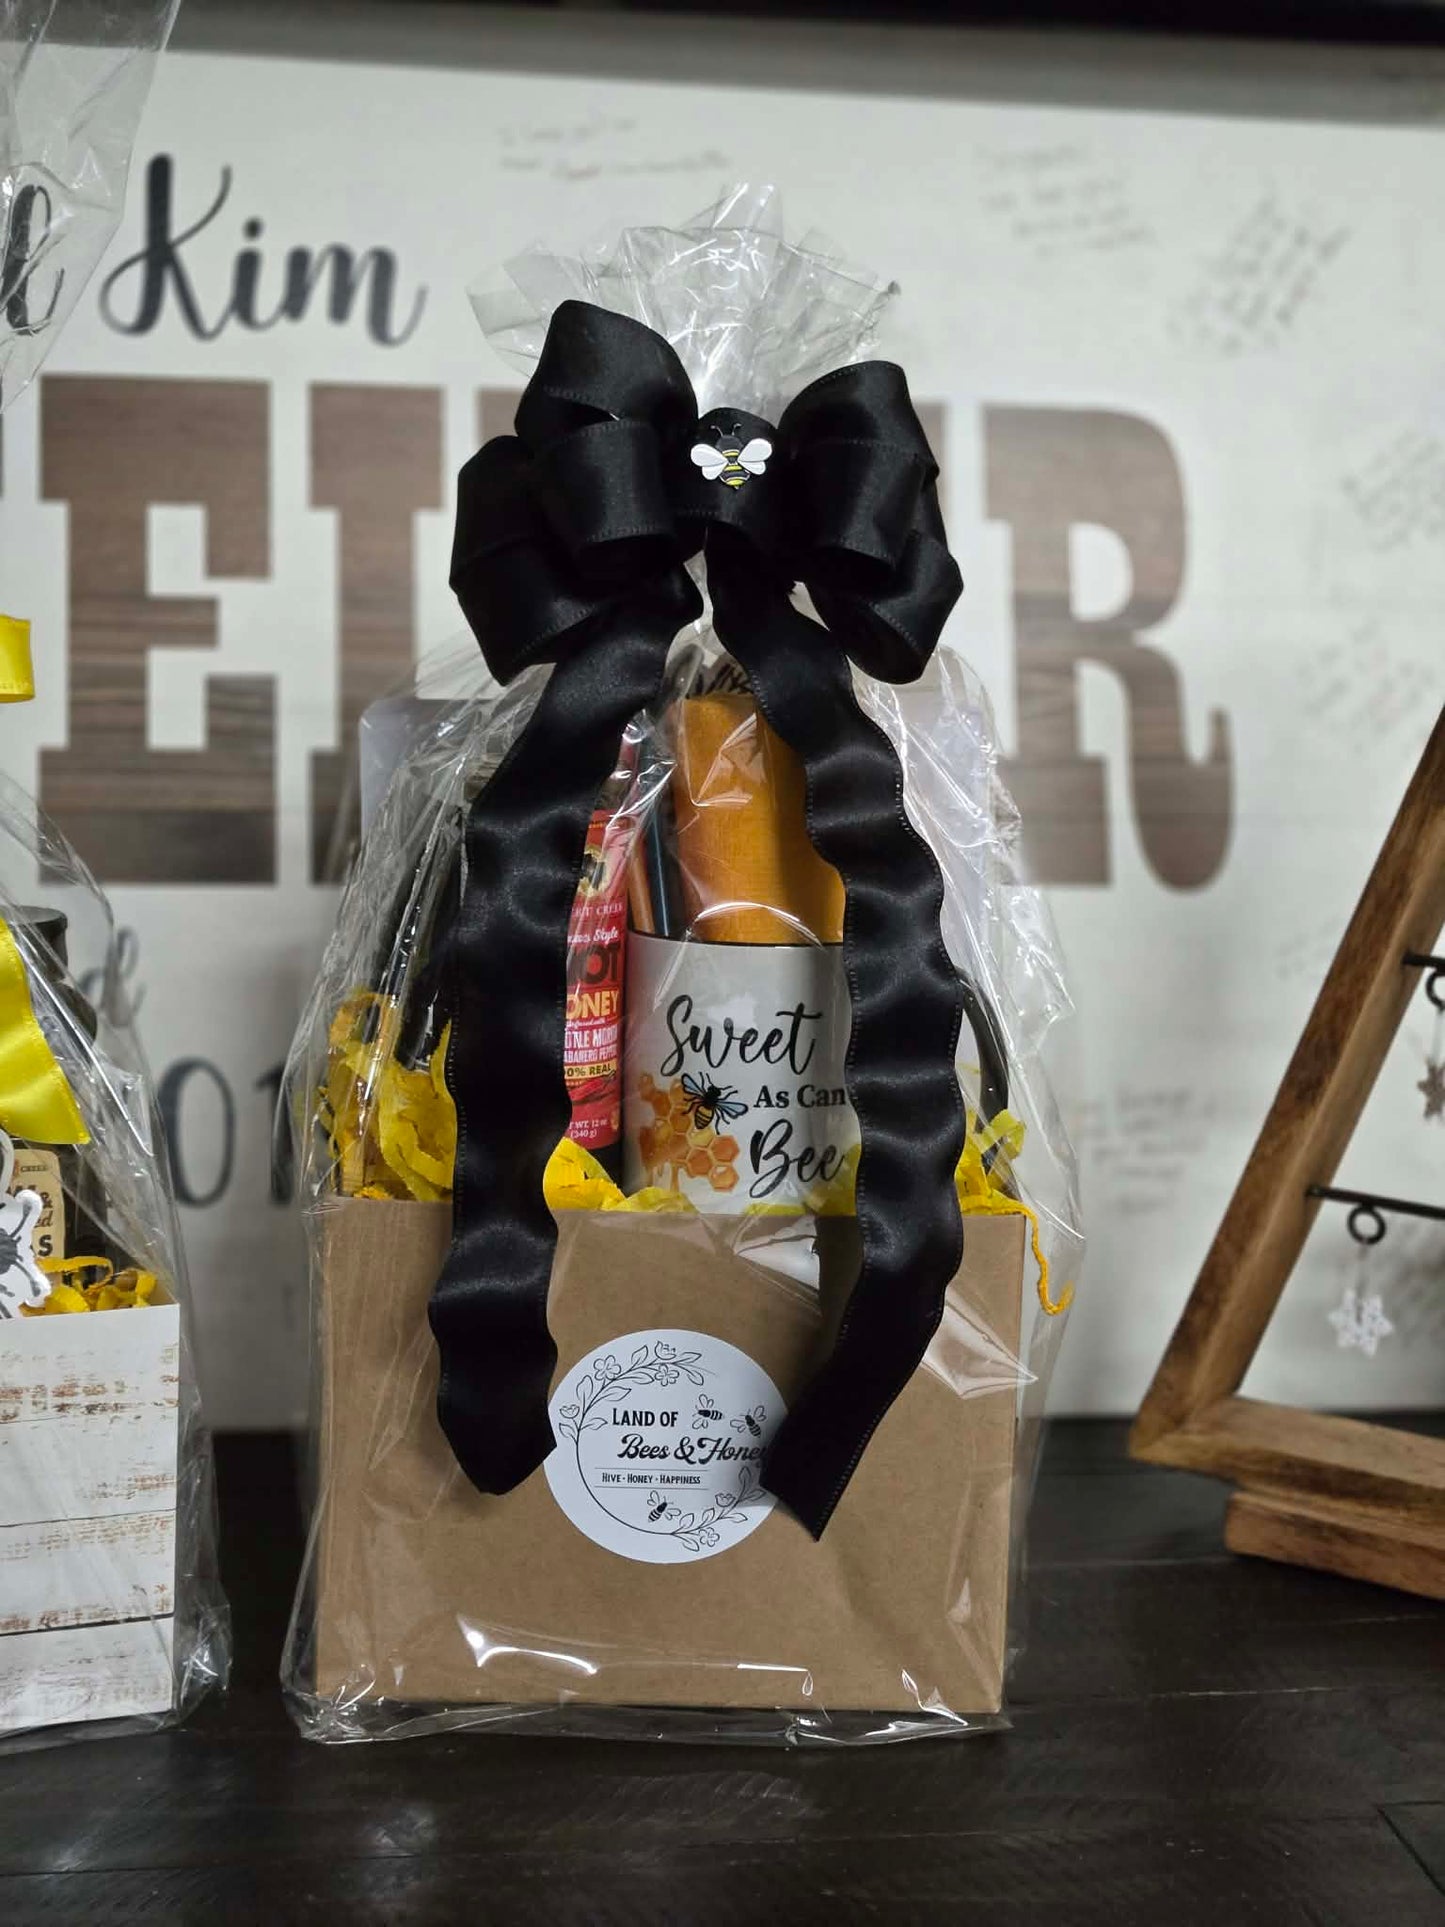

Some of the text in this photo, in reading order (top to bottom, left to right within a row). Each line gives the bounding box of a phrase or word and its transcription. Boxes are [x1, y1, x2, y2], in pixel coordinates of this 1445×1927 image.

[98, 153, 428, 347] Kim
[566, 990, 620, 1020] ONEY
[660, 994, 823, 1078] Sweet
[588, 1063, 612, 1076] REAL
[753, 1083, 847, 1109] As Can
[749, 1118, 845, 1199] Bee
[612, 1408, 679, 1428] LAND OF
[617, 1433, 671, 1460] Bees
[673, 1436, 697, 1466] &
[602, 1472, 701, 1485] HIVE HONEY HAPPINESS
